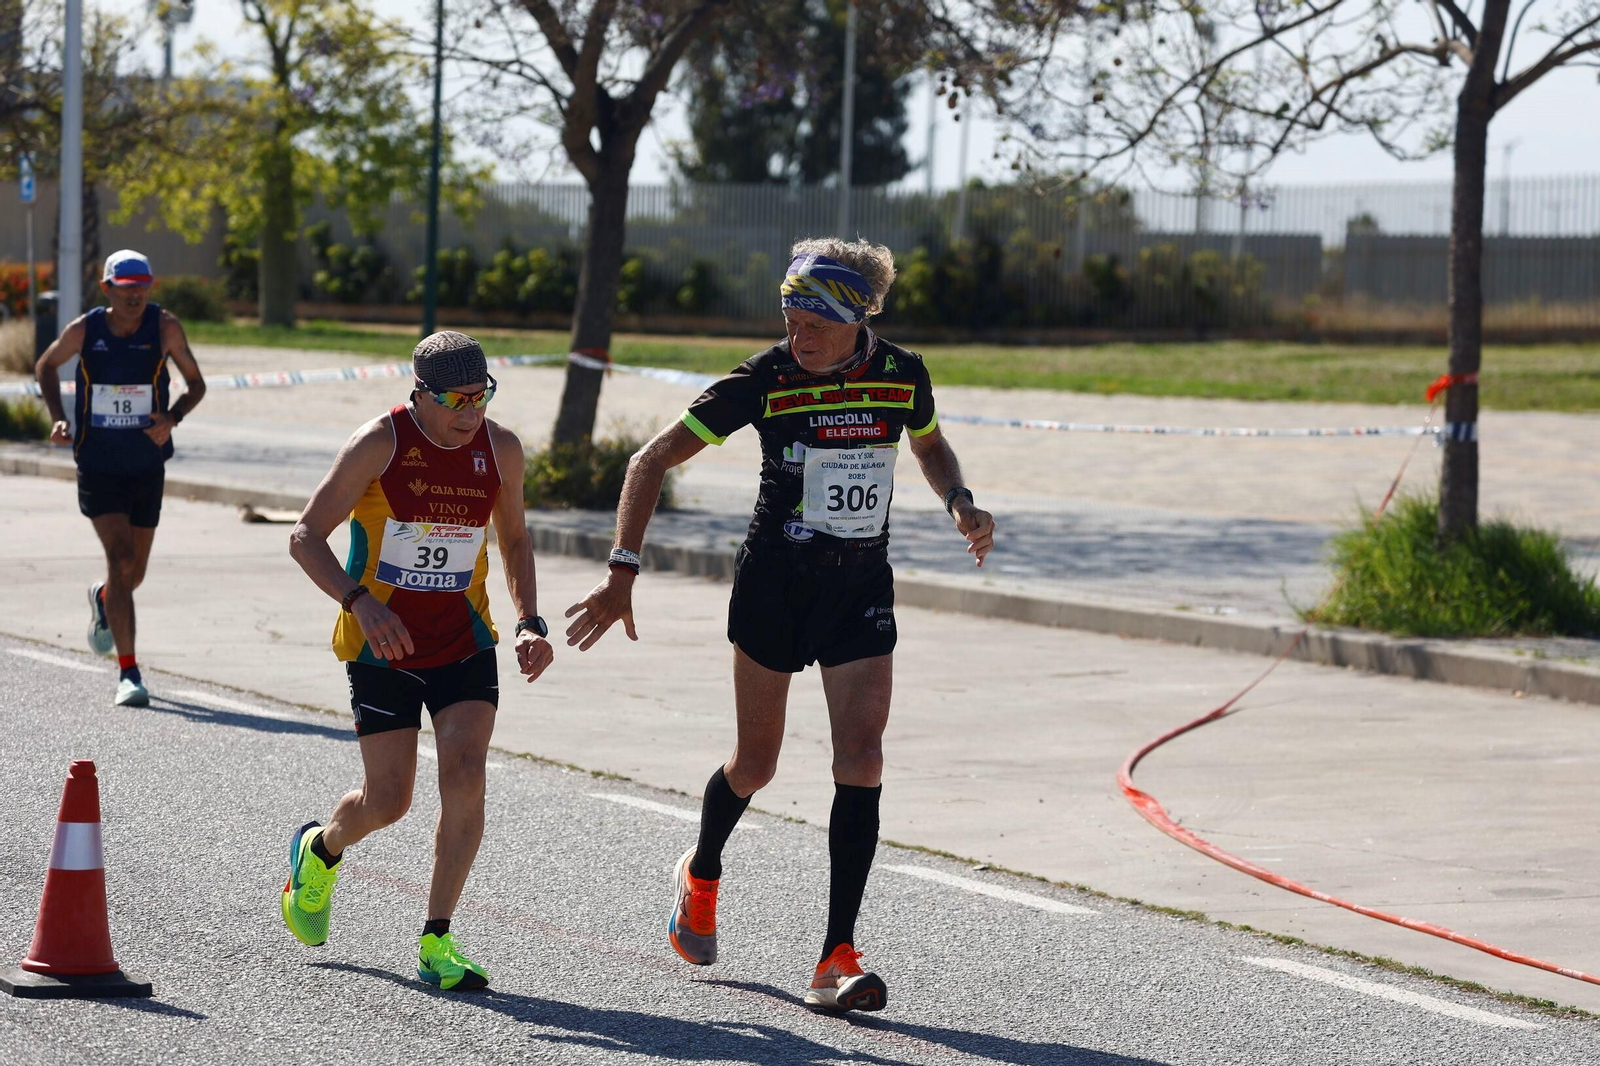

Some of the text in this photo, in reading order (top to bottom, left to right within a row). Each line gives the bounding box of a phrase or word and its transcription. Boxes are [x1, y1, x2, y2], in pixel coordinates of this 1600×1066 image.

[113, 400, 132, 414] 18
[771, 388, 914, 412] DEVIL BIKE TEAM
[809, 413, 873, 427] LINCOLN
[825, 426, 881, 438] ELECTRIC
[780, 461, 804, 476] Proje
[821, 461, 849, 470] CIUDAD
[430, 485, 488, 498] CAJA RURAL
[826, 483, 879, 513] 306
[428, 502, 469, 516] VINO
[413, 546, 449, 570] 39
